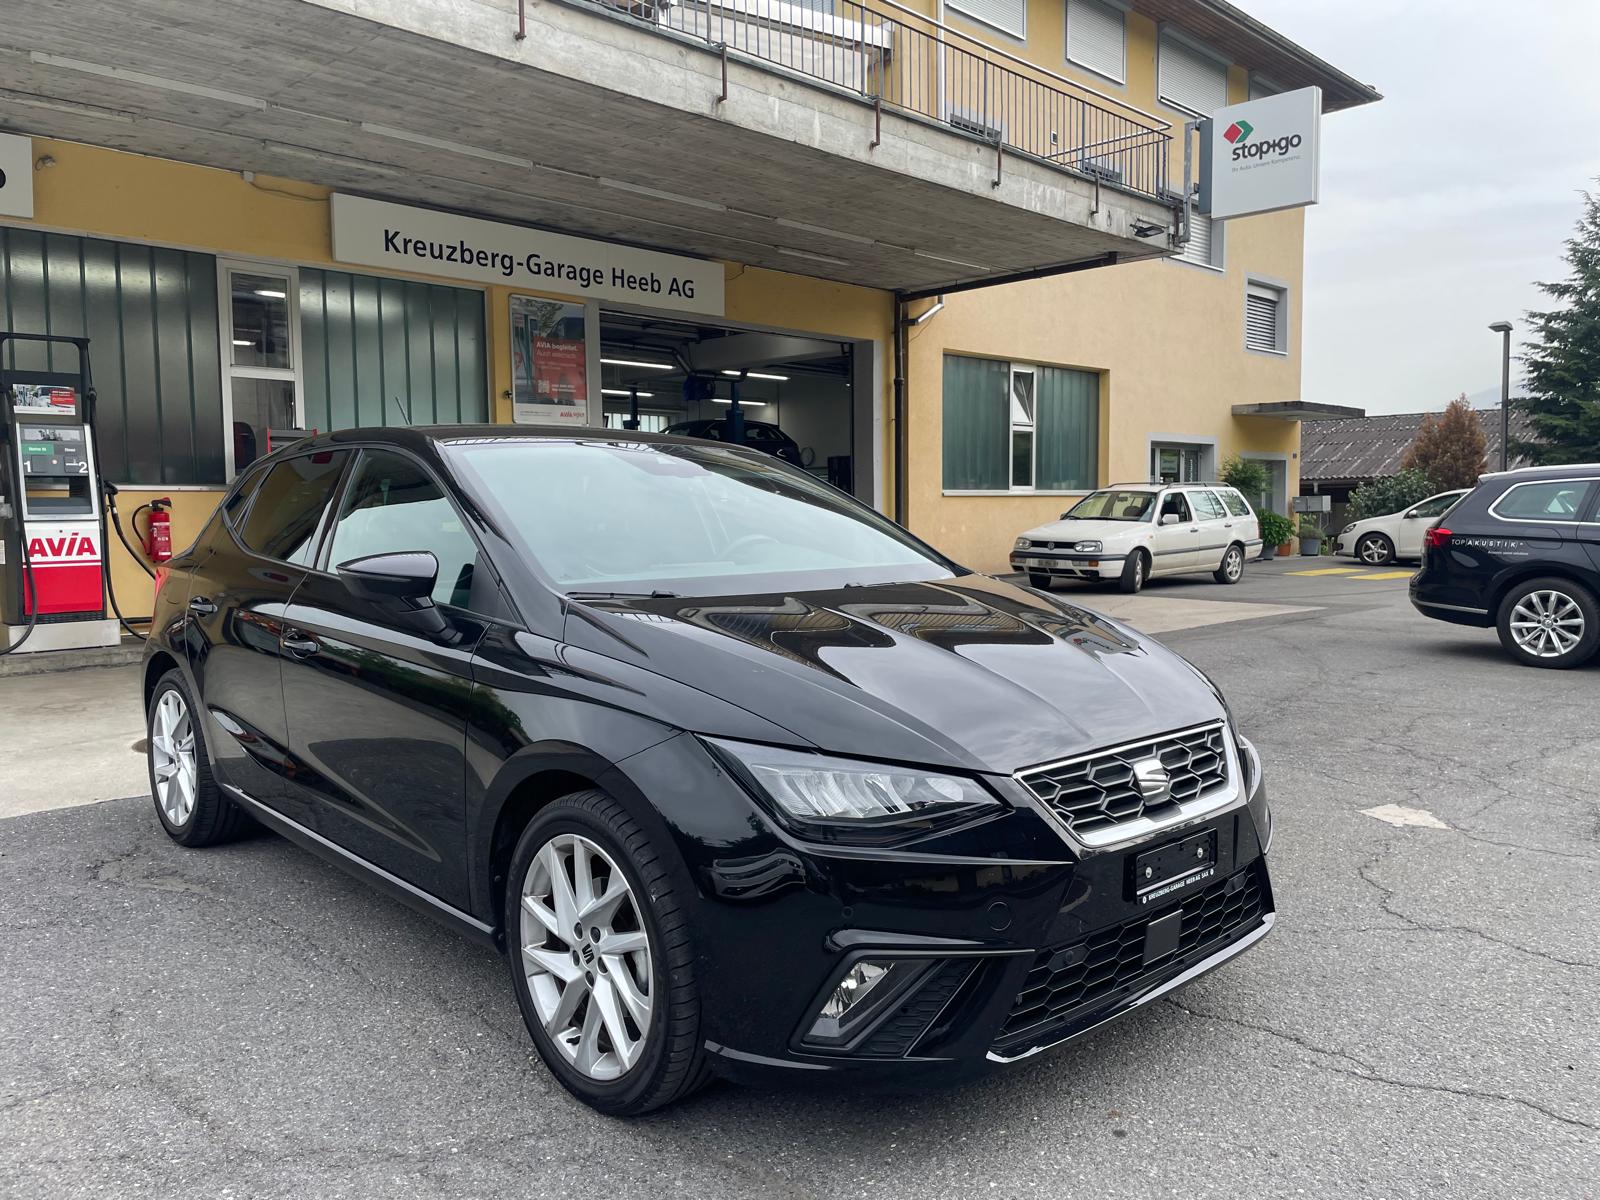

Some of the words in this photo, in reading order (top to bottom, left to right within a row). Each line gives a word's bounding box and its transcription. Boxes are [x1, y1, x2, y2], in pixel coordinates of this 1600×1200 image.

[1232, 134, 1302, 161] stop+go
[384, 229, 604, 288] Kreuzberg-Garage
[612, 267, 661, 294] Heeb
[668, 277, 695, 299] AG
[536, 341, 551, 349] AVIA
[24, 460, 32, 473] 1
[78, 461, 89, 474] 2
[28, 532, 97, 557] AVIA
